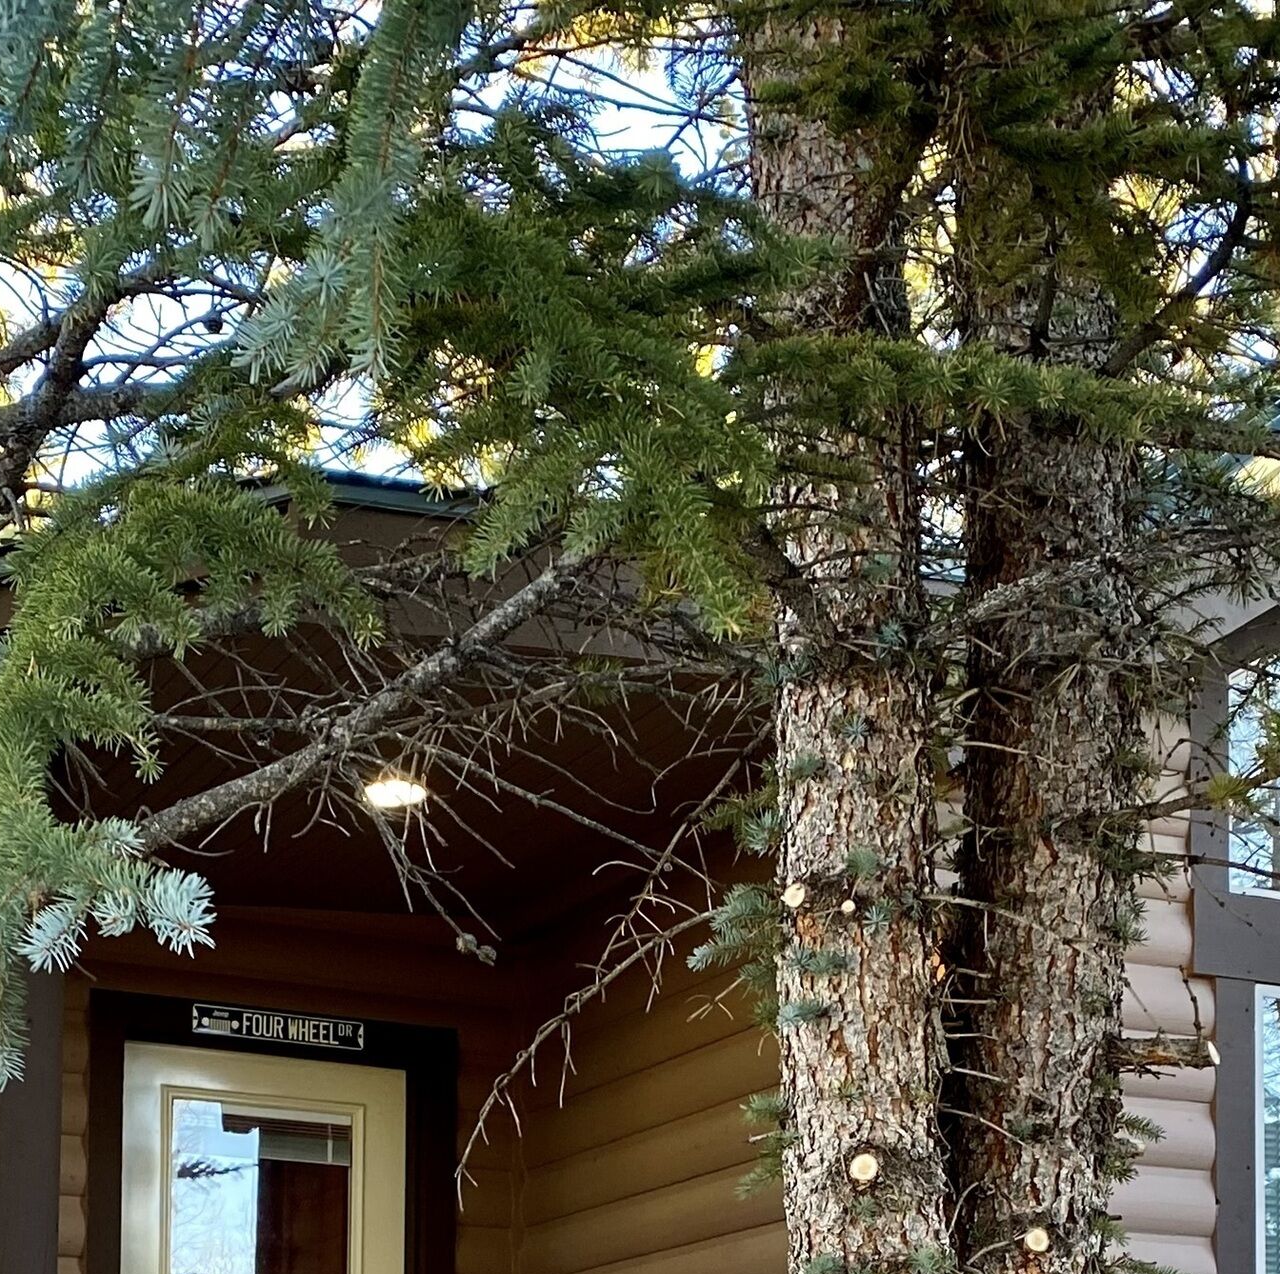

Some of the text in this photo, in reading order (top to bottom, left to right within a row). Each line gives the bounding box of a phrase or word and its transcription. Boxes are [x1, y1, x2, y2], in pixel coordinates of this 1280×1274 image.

[242, 1012, 353, 1045] FOUR WHEEL DR
